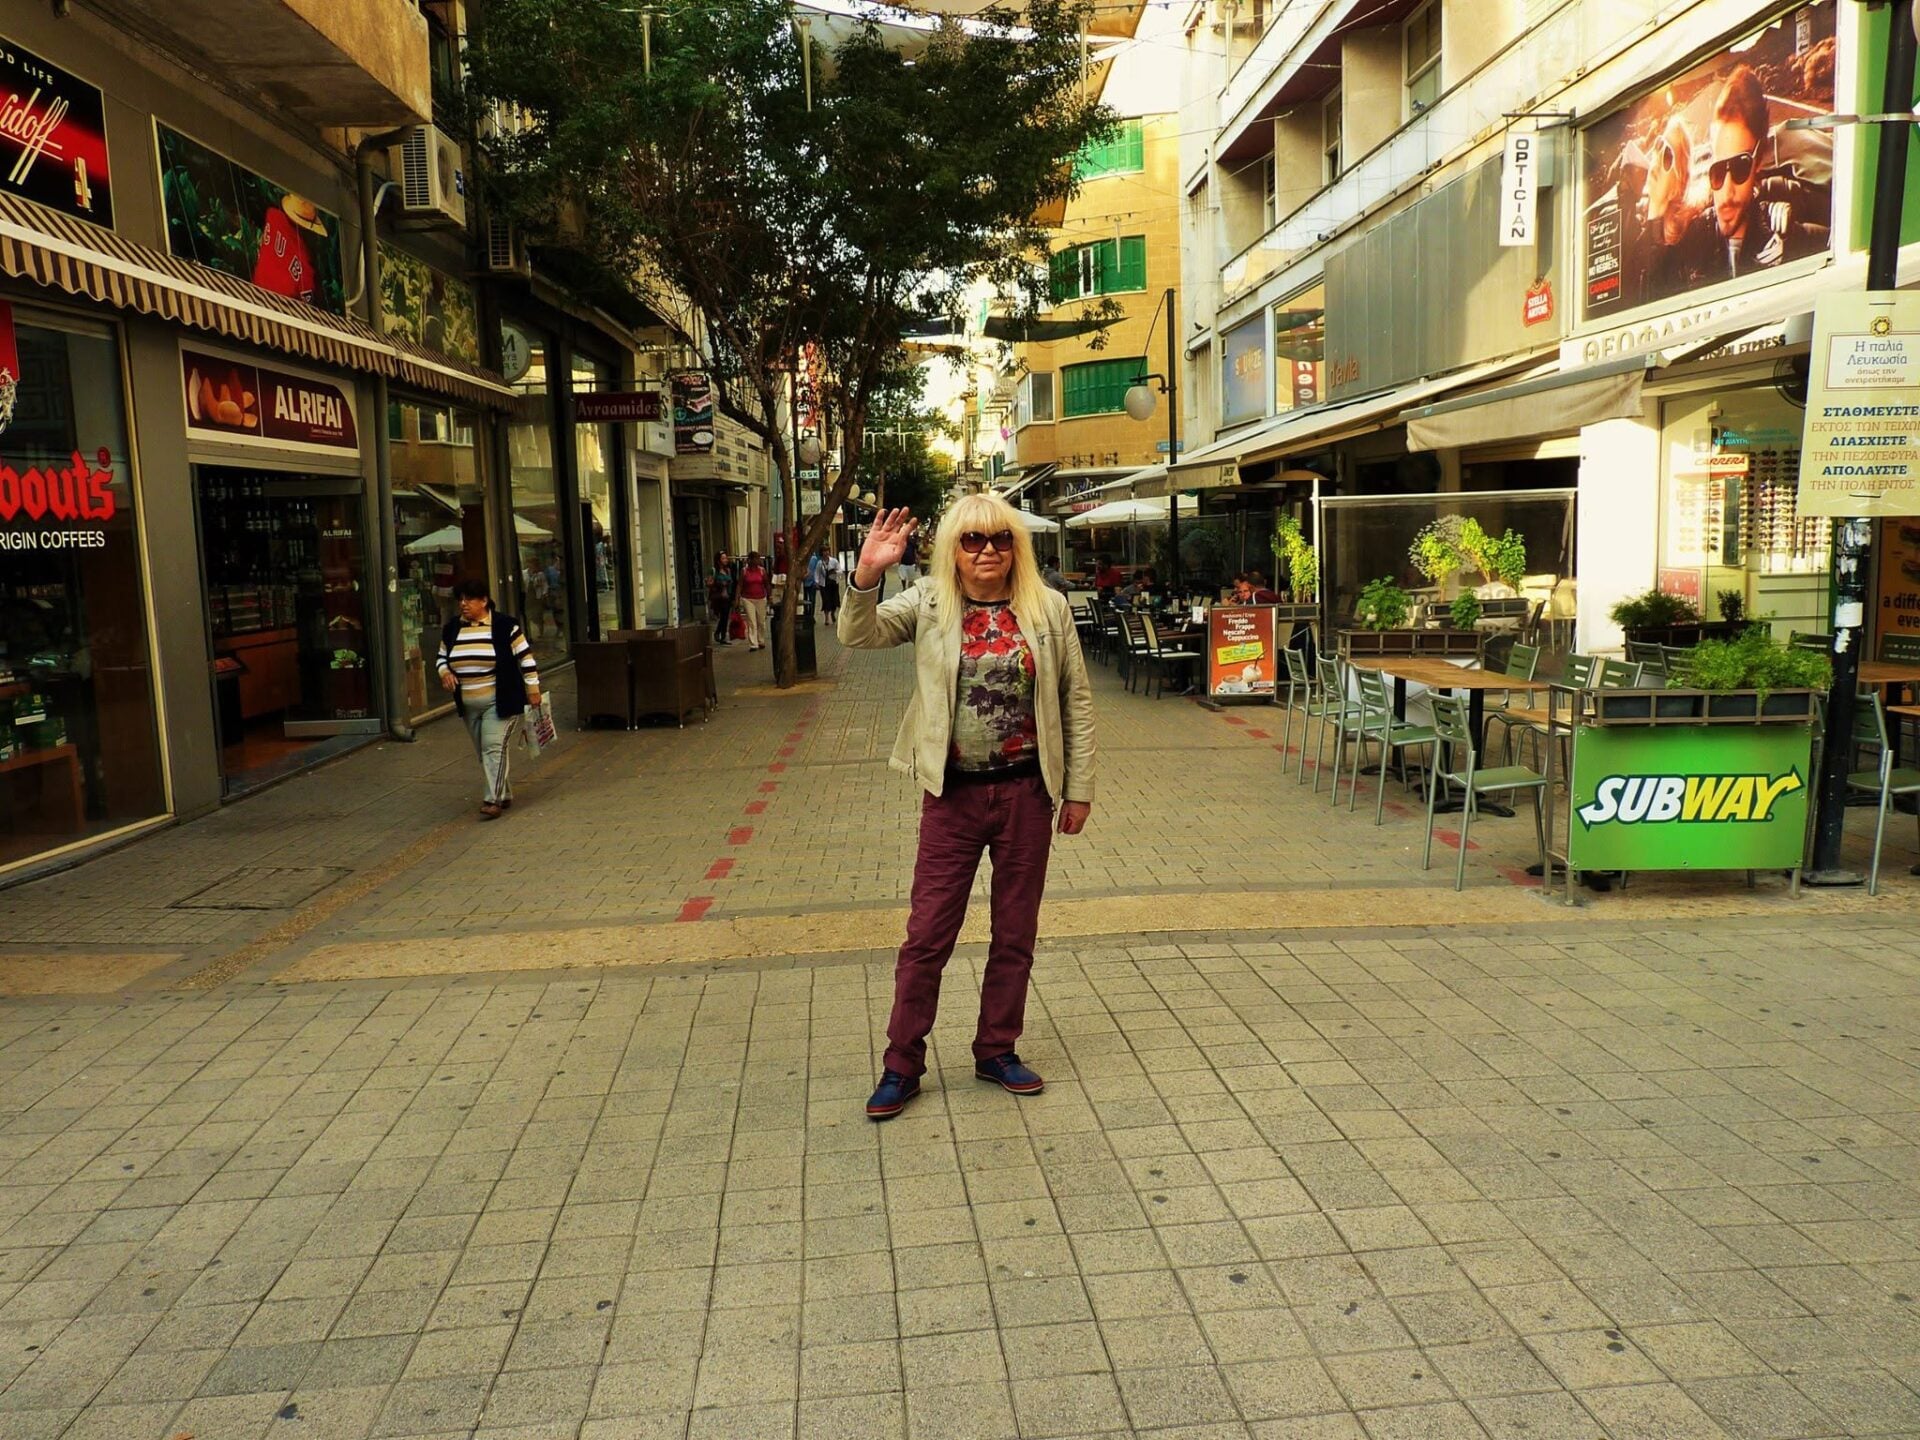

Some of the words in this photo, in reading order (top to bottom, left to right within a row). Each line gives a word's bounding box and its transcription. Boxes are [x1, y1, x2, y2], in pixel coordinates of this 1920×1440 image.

[23, 62, 54, 85] LIFE
[1511, 138, 1530, 238] OPTICIAN
[1739, 333, 1787, 356] EXPRESS
[1855, 341, 1866, 352] Η
[1869, 339, 1903, 353] παλιά
[1847, 354, 1908, 366] Λευκωσία
[275, 385, 342, 429] ALRIFAI
[577, 399, 660, 417] Avraamides
[1823, 405, 1919, 417] ΣΤΑΘΜΕΥΣΤΕ
[1811, 422, 1852, 432] ΕΚΤΟΣ
[1855, 421, 1880, 431] ΤΩΝ
[1829, 435, 1908, 446] ΔΙΑΣΧΙΣΤΕ
[1694, 456, 1746, 467] CARRERA
[1812, 451, 1839, 462] ΤΗΝ
[1842, 450, 1918, 461] ΠΕΖΟΓΕΦΥΡΑ
[1822, 464, 1908, 475] ΑΠΟΛΑΥΣΤΕ
[1810, 480, 1836, 490] ΤΗΝ
[1840, 480, 1875, 490] ΠΟΛΗ
[1877, 479, 1916, 490] ΕΝΤΟΣ
[40, 531, 105, 548] COFFEES
[1227, 634, 1260, 642] Cappuccino
[1578, 770, 1803, 827] SUBWAY
